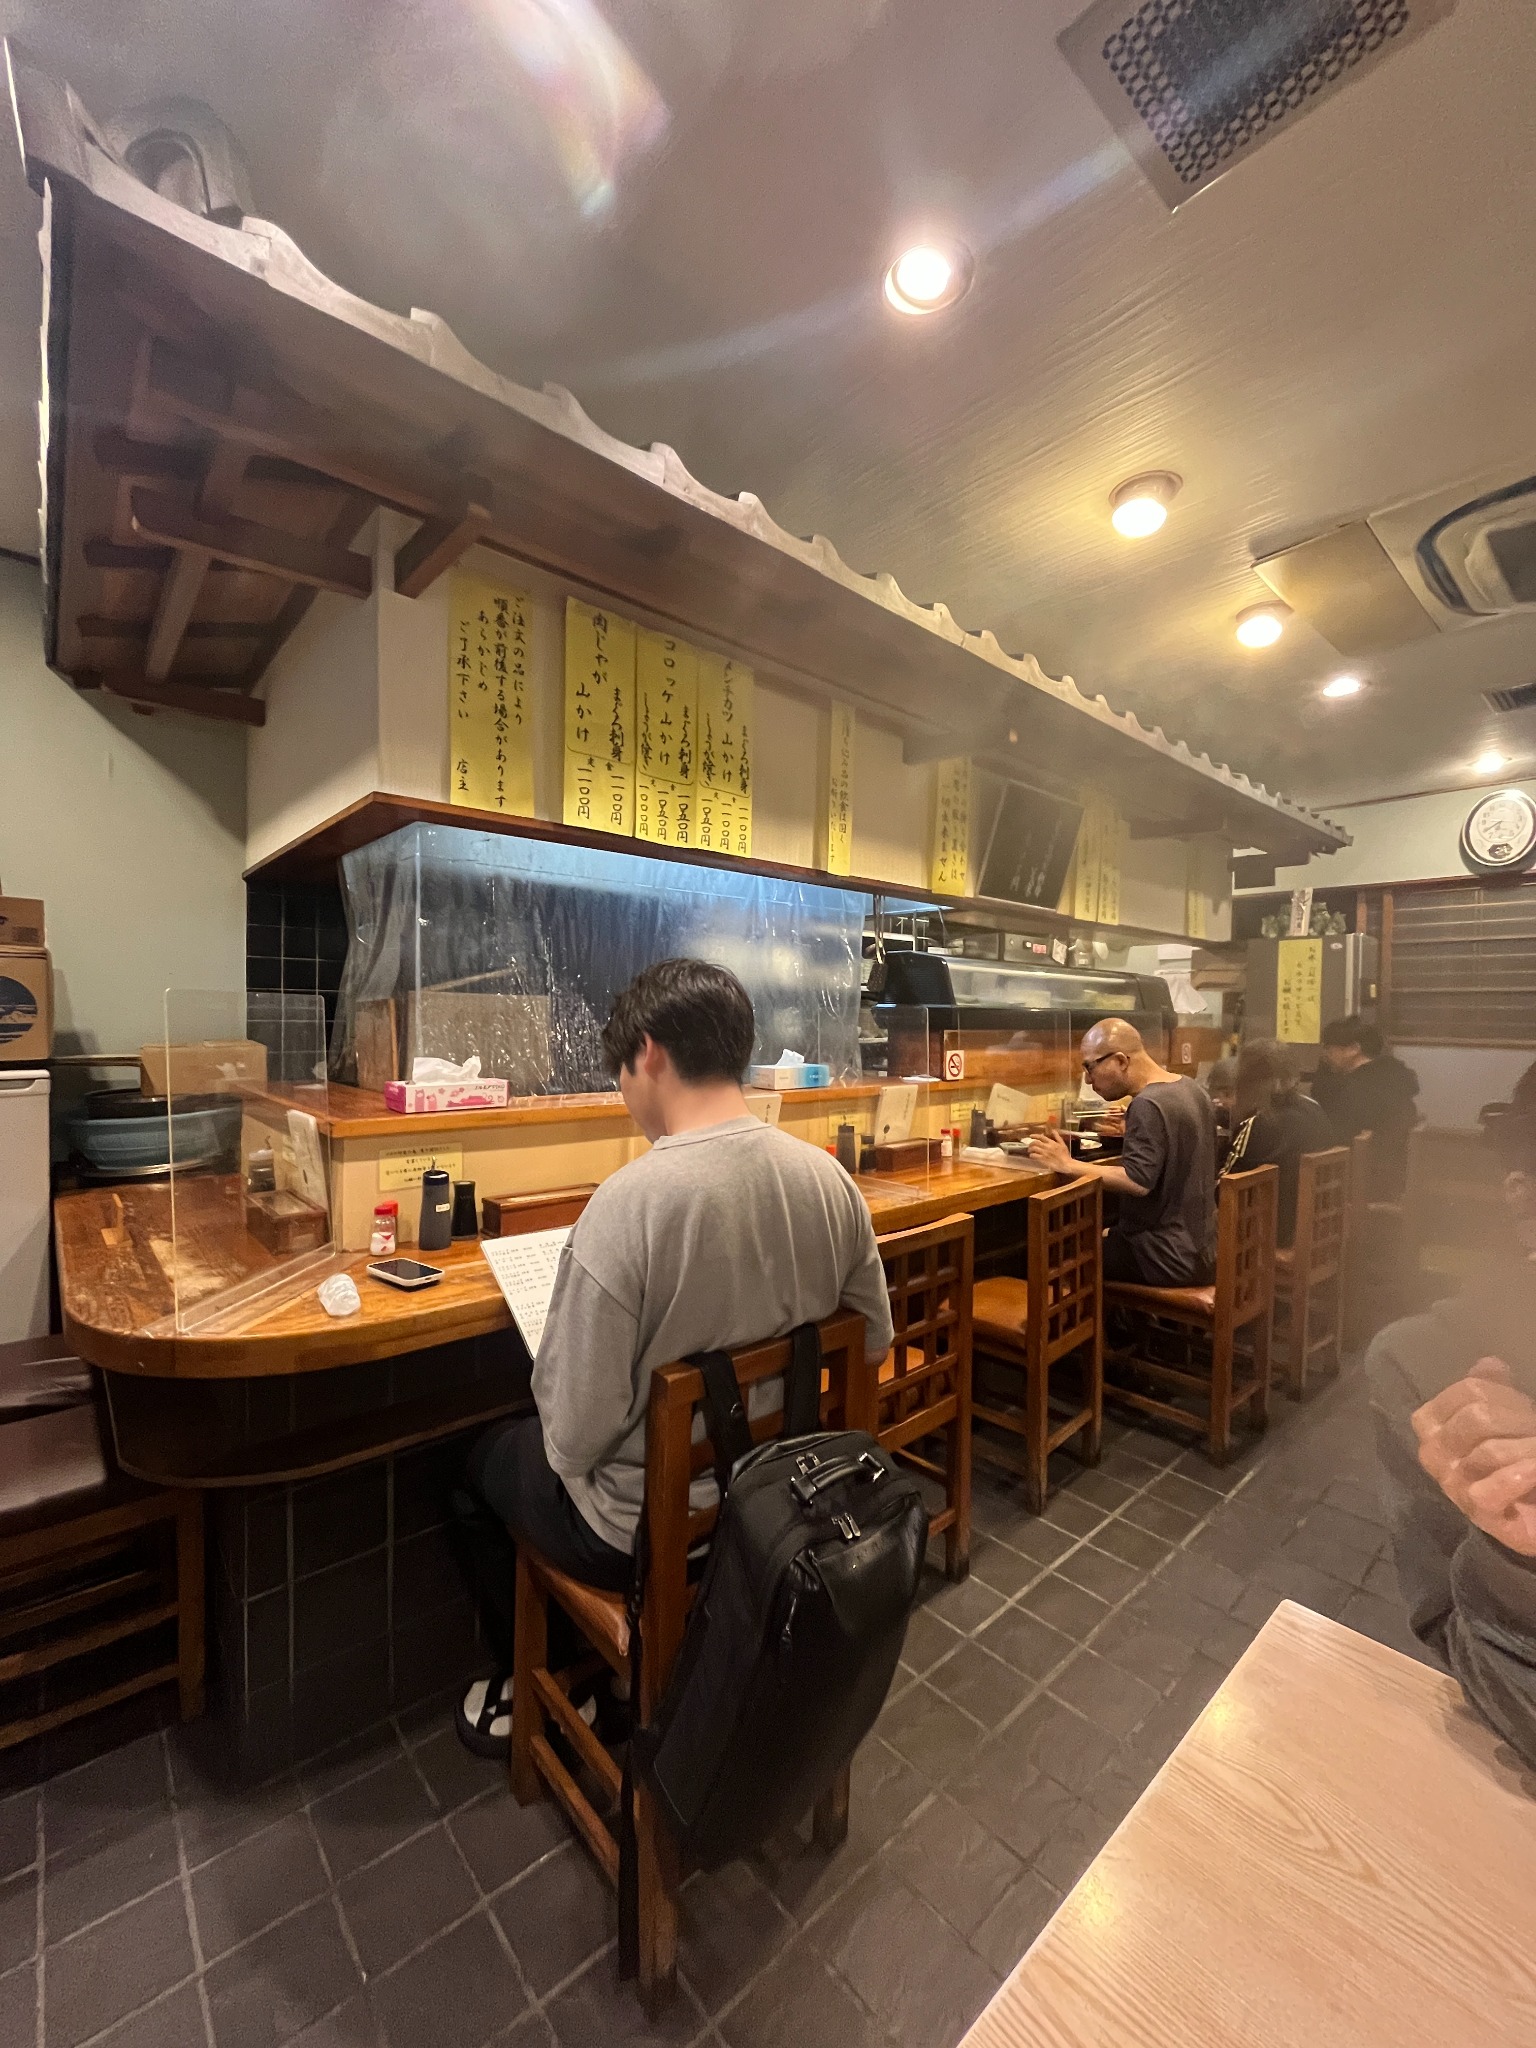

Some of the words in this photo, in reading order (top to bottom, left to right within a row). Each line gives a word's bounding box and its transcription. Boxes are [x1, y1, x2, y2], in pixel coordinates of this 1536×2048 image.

[456, 621, 471, 719] ご了承下さい
[478, 610, 490, 691] あらかじめ
[512, 597, 526, 725] ご注文の品により
[662, 640, 676, 702] コロッケ
[493, 598, 509, 807] 順番が前後する場合があります
[576, 682, 592, 743] 山かけ
[660, 712, 673, 765] 山かけ
[722, 733, 734, 783] 山かけ
[456, 758, 469, 791] 店主
